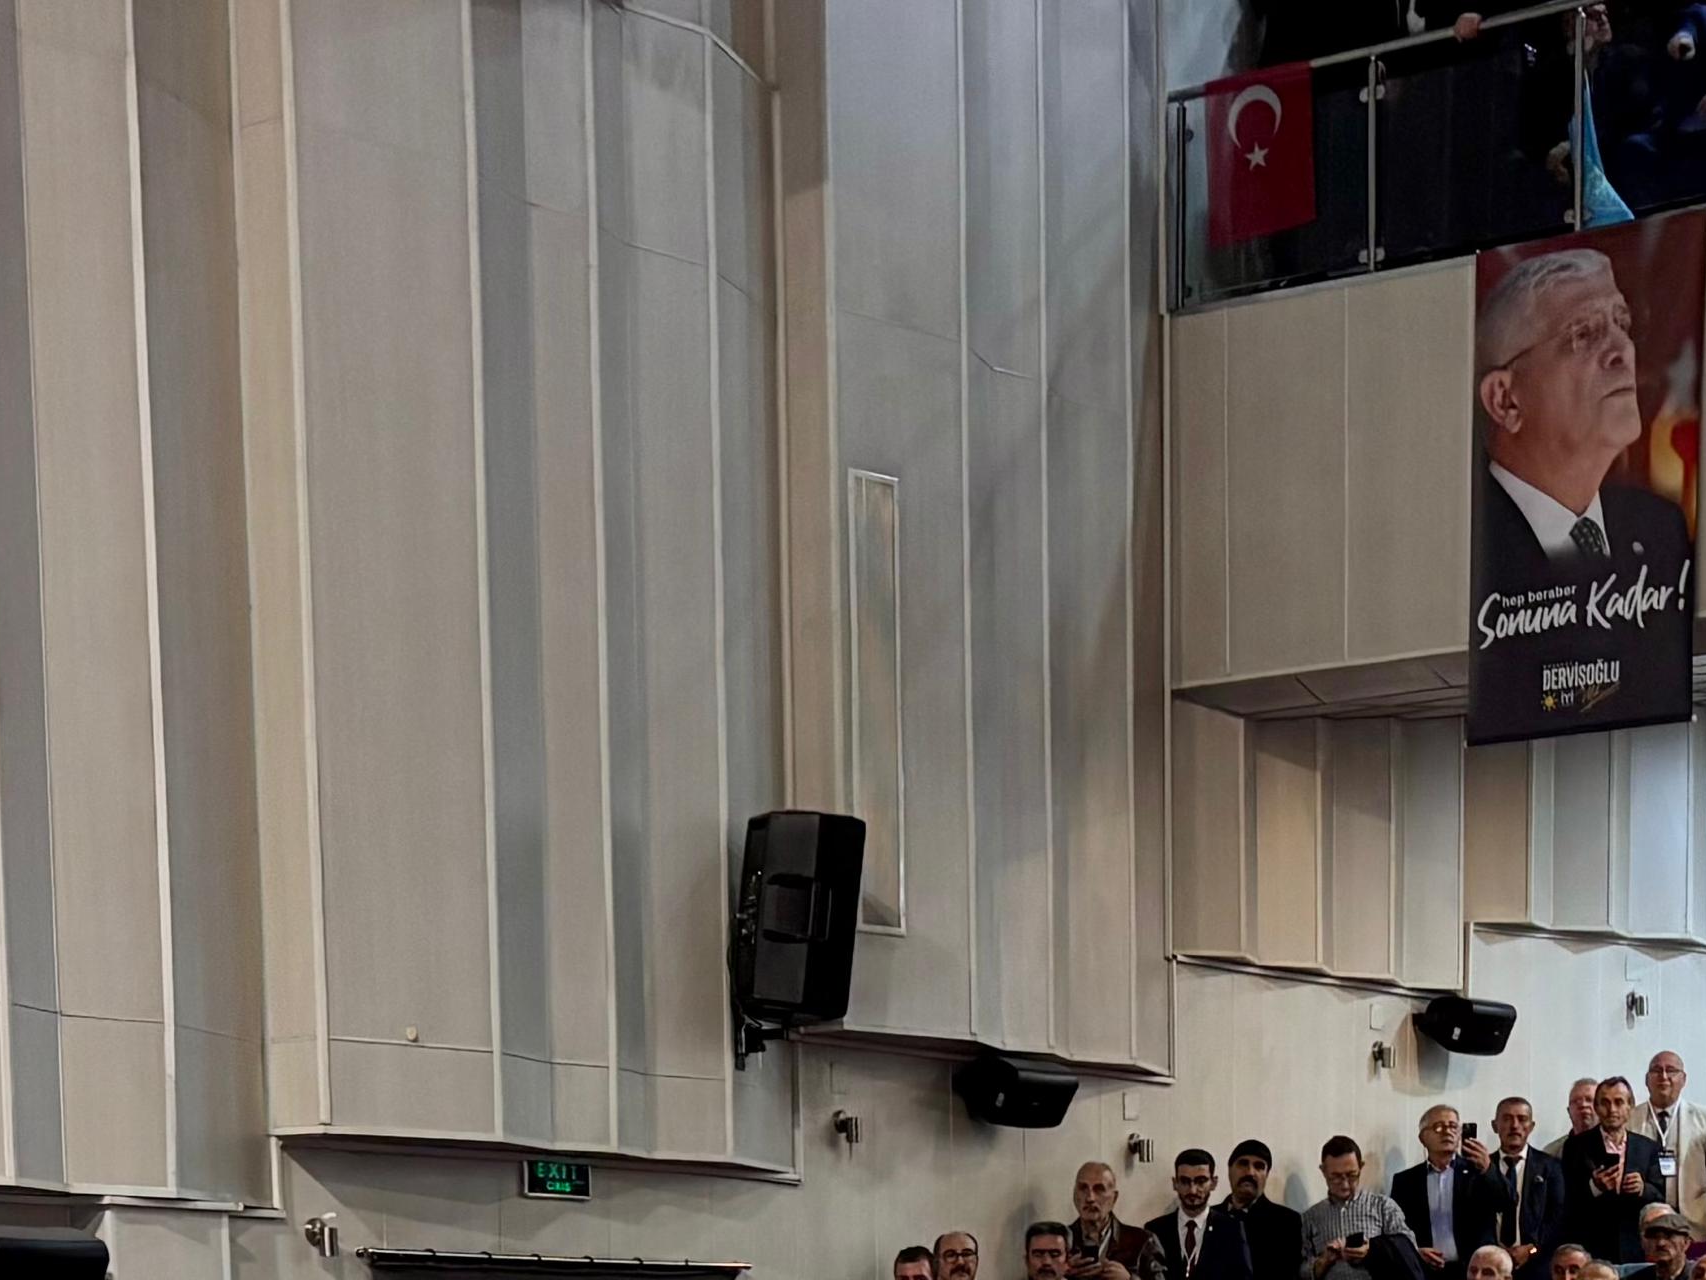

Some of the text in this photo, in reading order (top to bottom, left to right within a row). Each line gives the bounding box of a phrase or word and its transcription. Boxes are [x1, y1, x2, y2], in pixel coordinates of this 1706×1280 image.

[1501, 585, 1578, 608] hep beraber
[1477, 592, 1578, 650] Sonuna
[1543, 658, 1621, 692] DERVİŞOĞLU
[537, 1162, 577, 1180] EXIT
